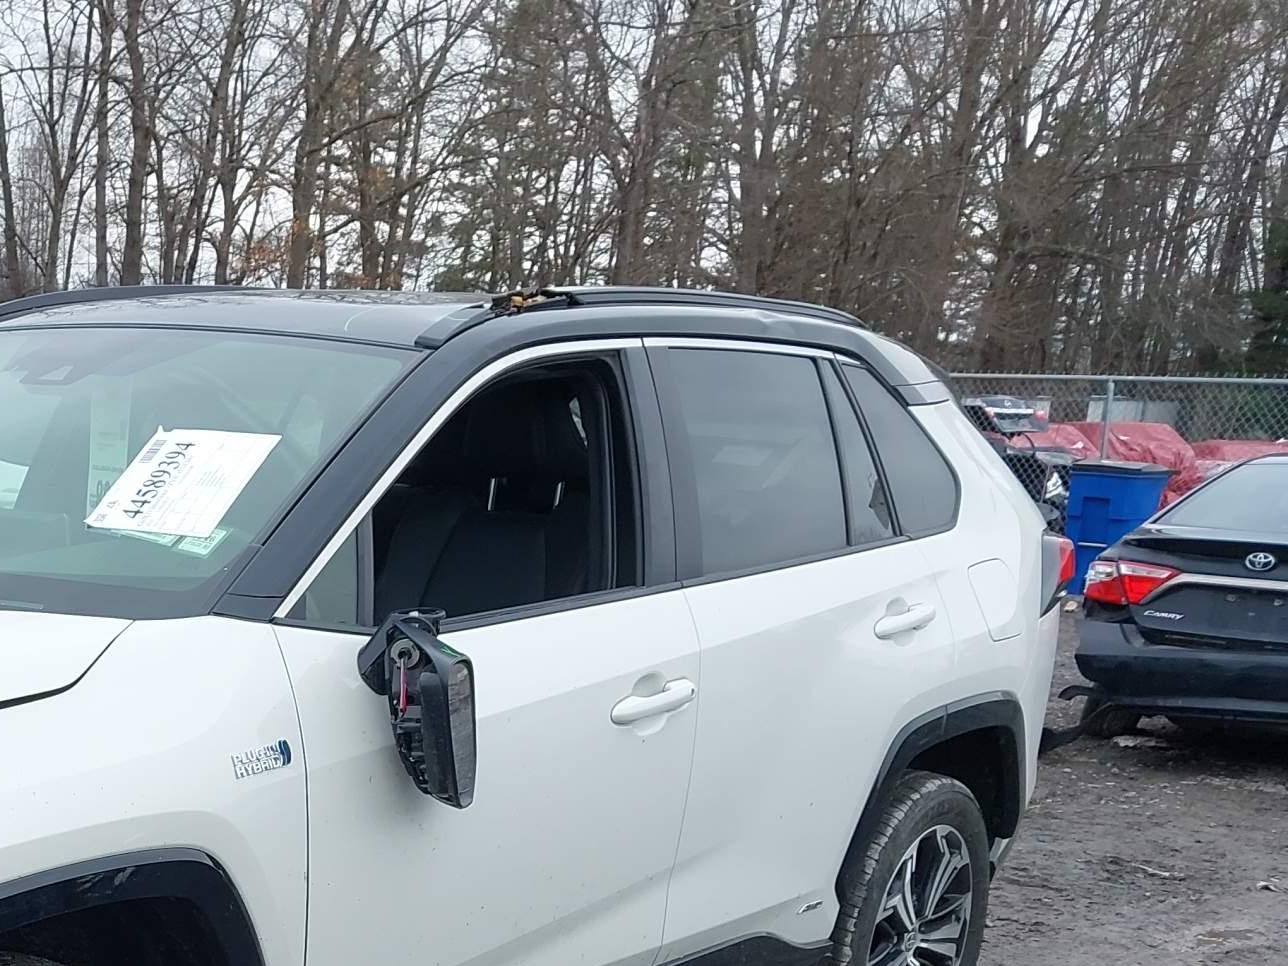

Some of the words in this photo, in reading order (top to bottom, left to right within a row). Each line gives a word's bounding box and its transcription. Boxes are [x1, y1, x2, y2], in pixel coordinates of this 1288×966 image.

[123, 442, 196, 519] 44589394
[1143, 609, 1185, 621] CAMRY
[234, 756, 283, 780] HYBRID
